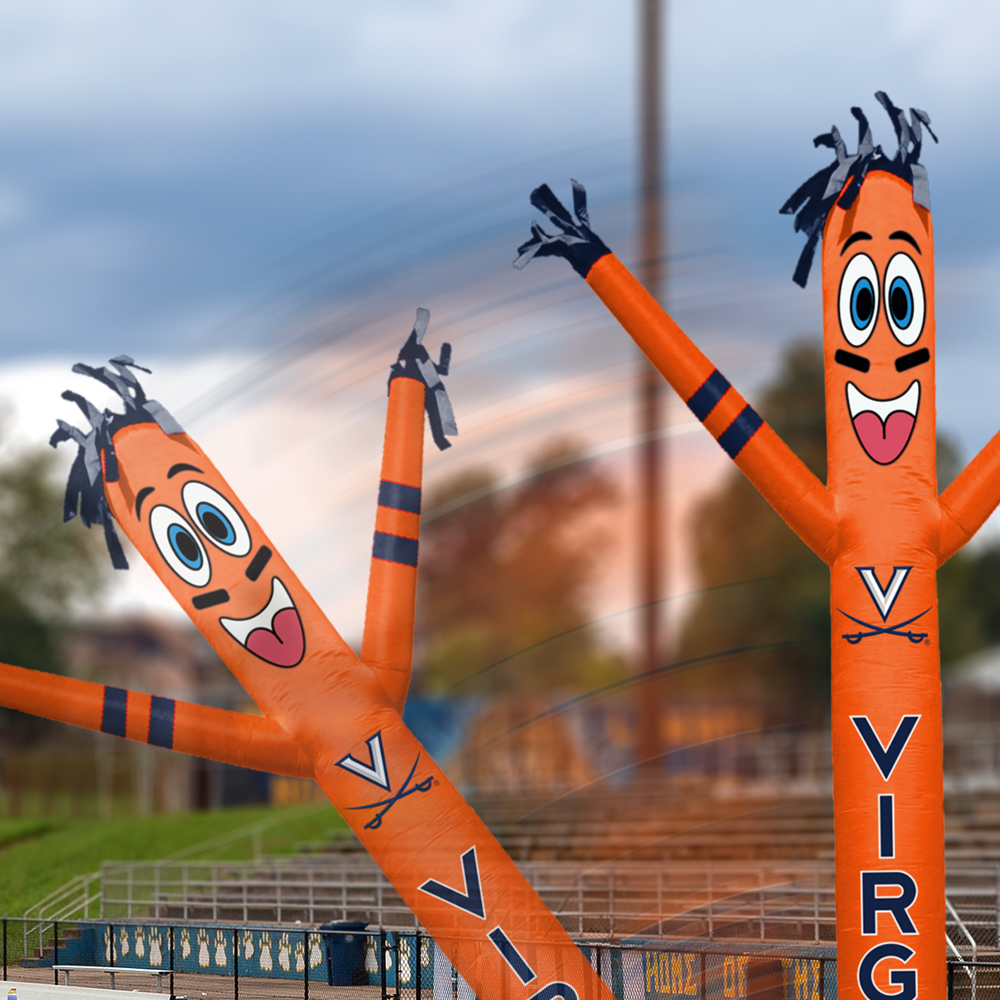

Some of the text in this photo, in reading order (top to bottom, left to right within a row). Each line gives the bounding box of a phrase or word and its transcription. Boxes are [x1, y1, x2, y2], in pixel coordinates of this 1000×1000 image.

[855, 566, 912, 623] V
[334, 730, 391, 792] V
[645, 951, 697, 995] HOME
[723, 956, 749, 998] OF
